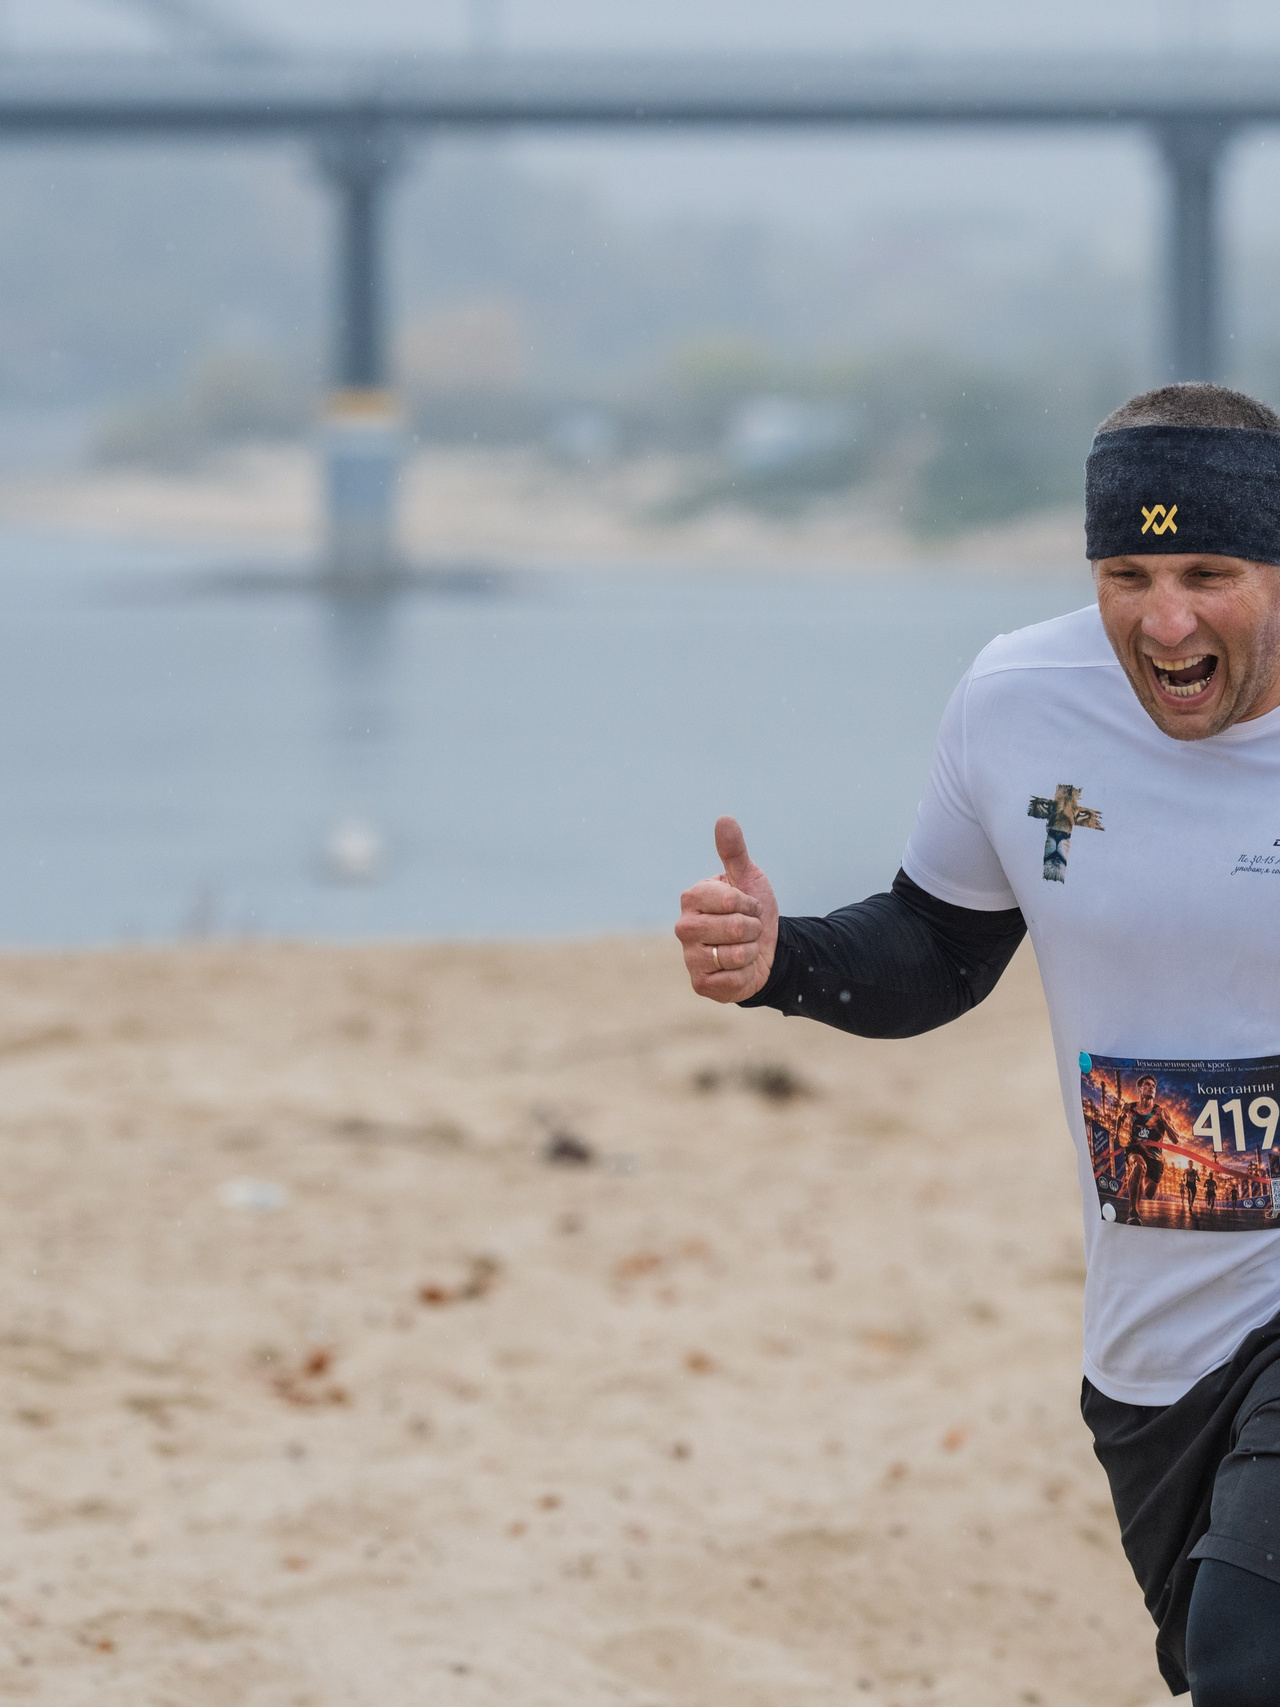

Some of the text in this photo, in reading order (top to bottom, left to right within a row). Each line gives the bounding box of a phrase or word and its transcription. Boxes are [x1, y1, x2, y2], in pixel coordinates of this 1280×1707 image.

[1207, 1061, 1231, 1070] кросс
[1197, 1082, 1275, 1095] Константин
[1192, 1096, 1280, 1152] 419
